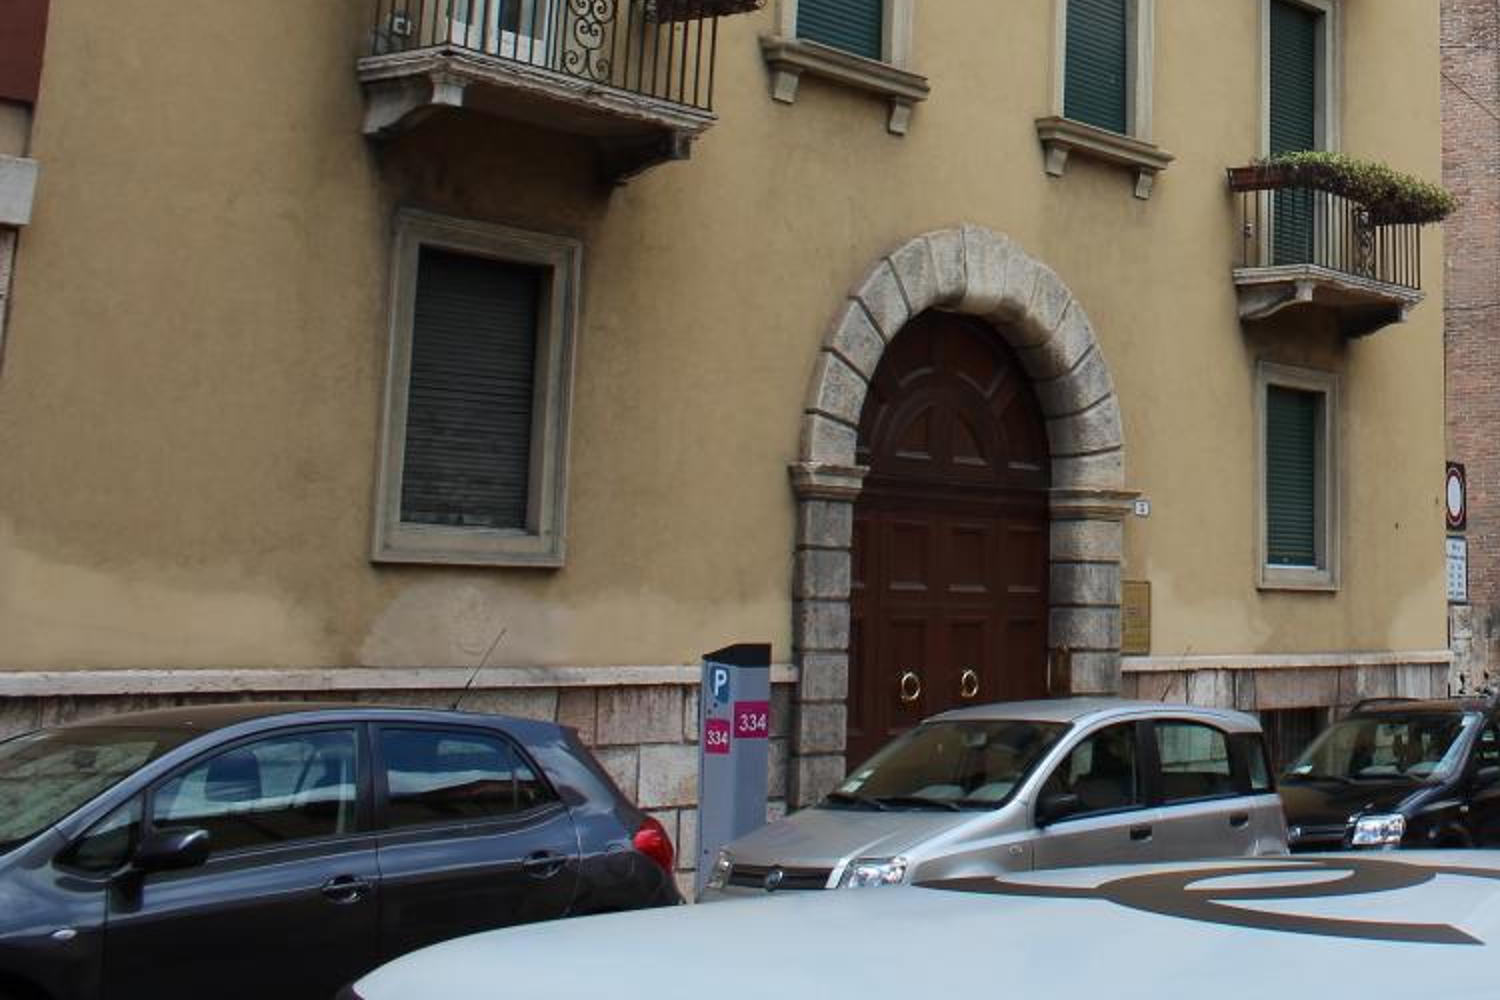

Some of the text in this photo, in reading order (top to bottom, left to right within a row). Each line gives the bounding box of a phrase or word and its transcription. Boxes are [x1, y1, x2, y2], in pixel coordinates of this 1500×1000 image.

[714, 669, 727, 697] P
[739, 713, 767, 732] 334
[707, 730, 728, 745] 334
